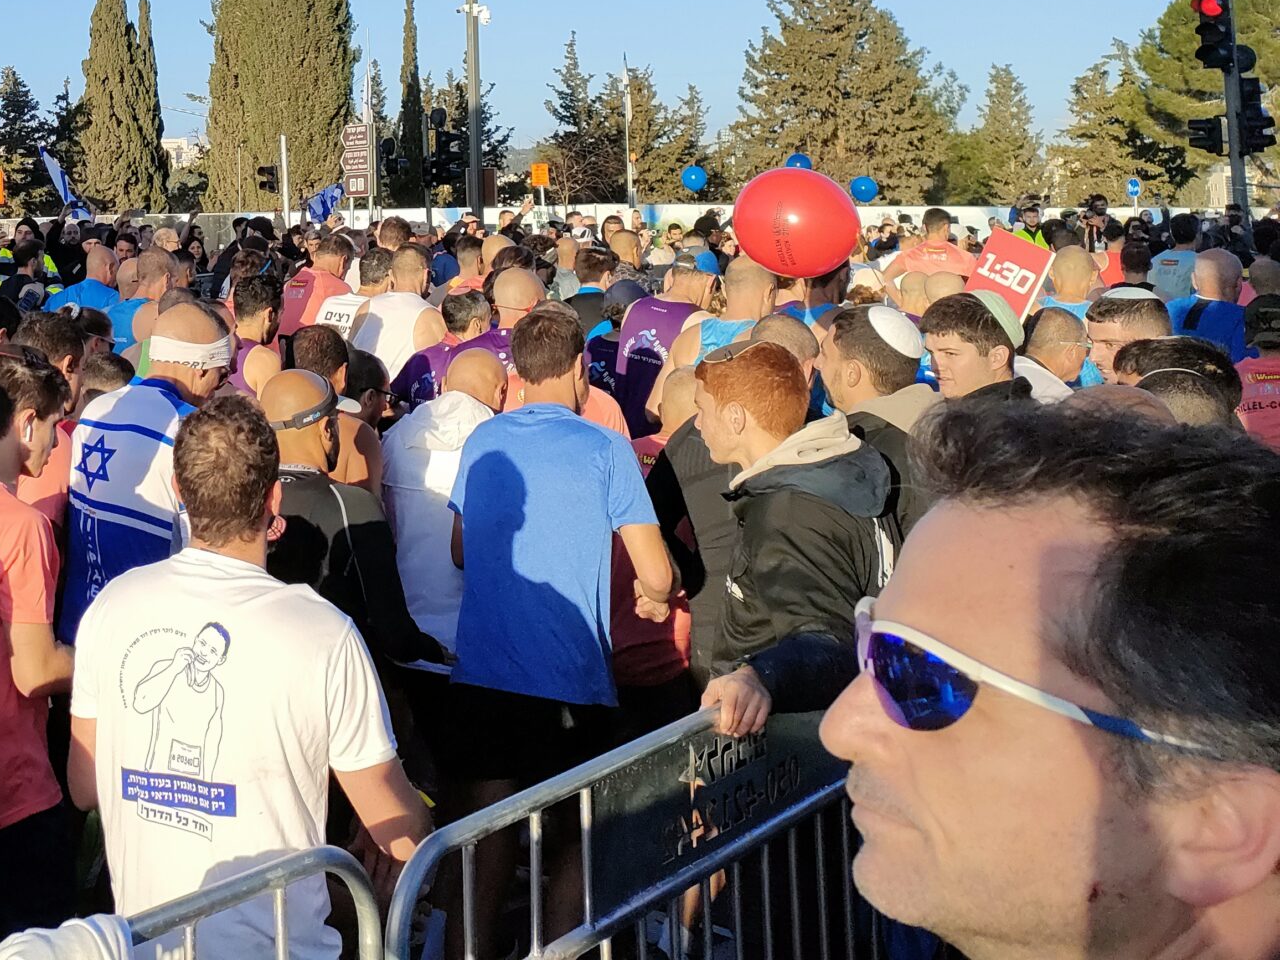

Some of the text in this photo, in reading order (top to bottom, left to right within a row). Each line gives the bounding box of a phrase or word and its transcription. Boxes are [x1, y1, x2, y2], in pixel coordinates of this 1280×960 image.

[977, 252, 1037, 295] 1:30
[324, 311, 350, 324] רצים
[150, 778, 172, 788] בעוז
[174, 779, 197, 792] נאמין
[198, 784, 209, 796] אם
[210, 787, 225, 798] רק
[127, 785, 226, 811] רק אם נאמין ודאי נצליח
[140, 803, 209, 833] יחד כל הדרך!
